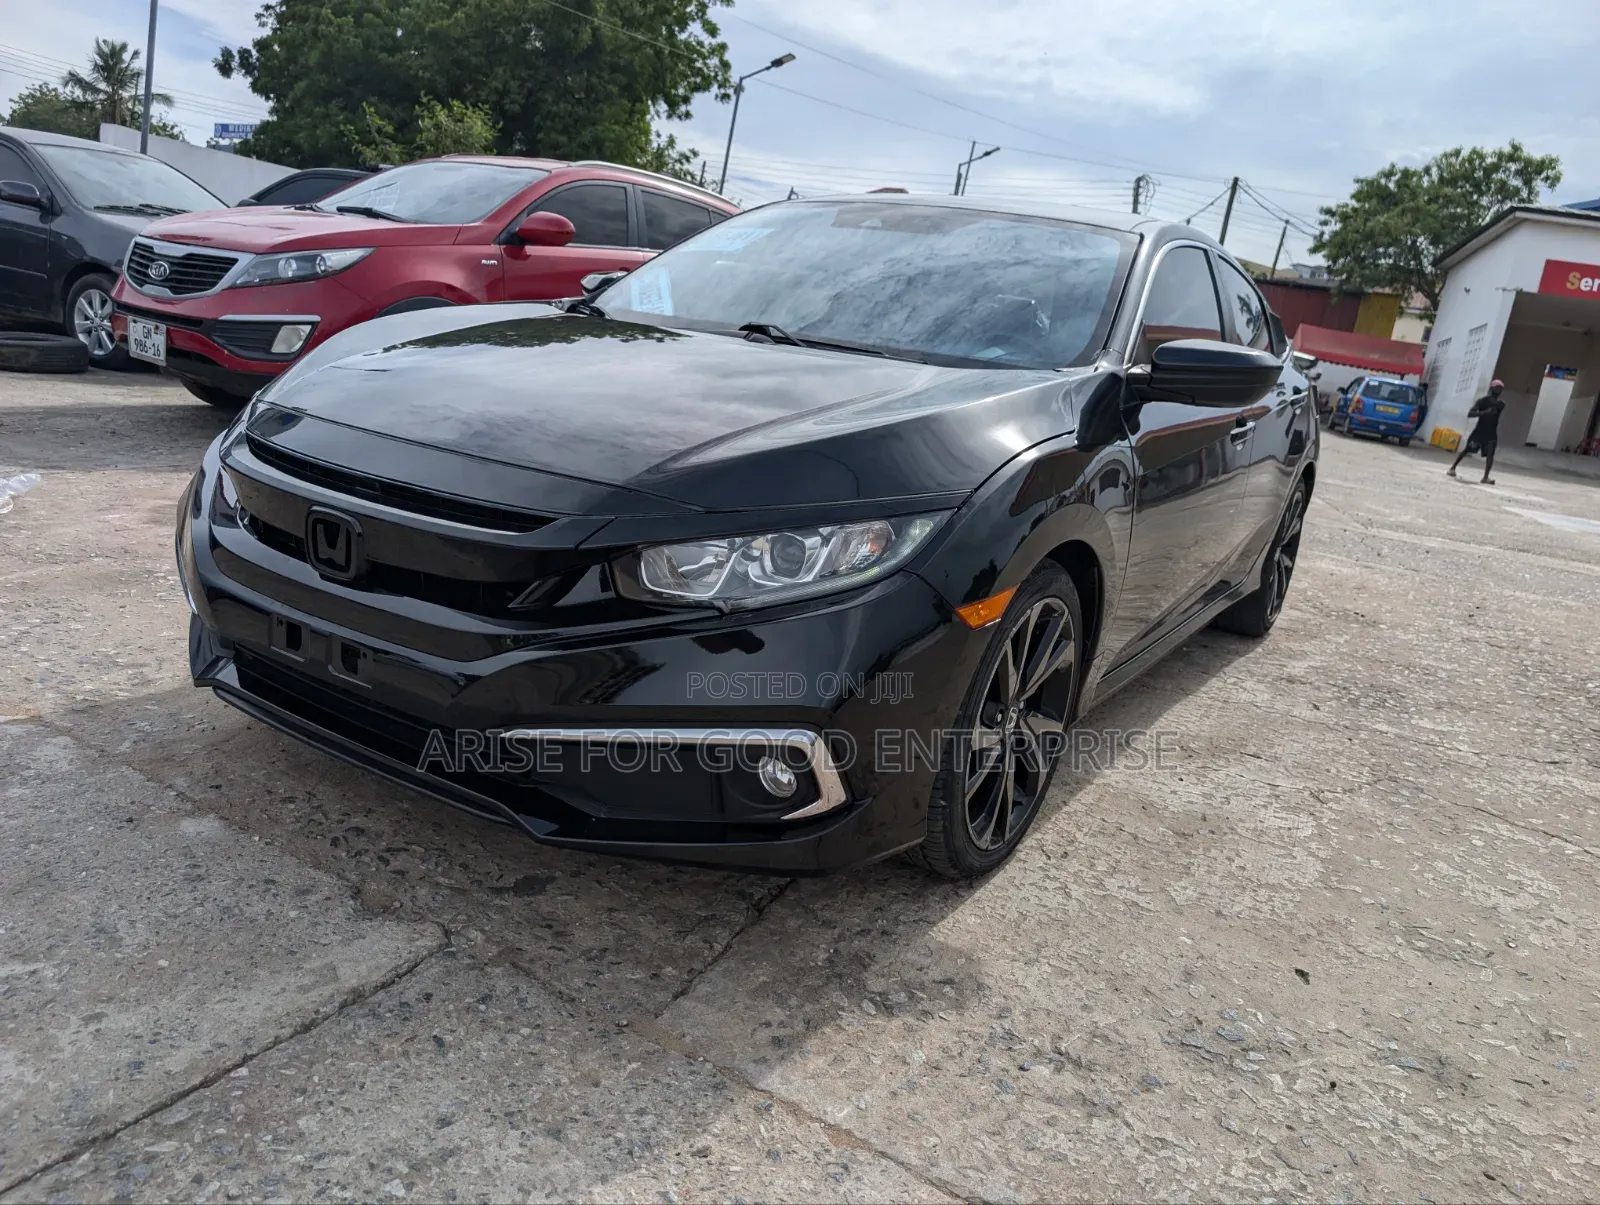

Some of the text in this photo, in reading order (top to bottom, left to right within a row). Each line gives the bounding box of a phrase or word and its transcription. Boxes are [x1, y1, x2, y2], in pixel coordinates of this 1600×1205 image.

[151, 264, 166, 277] KIA
[142, 325, 153, 340] GN
[134, 337, 161, 357] 986-16
